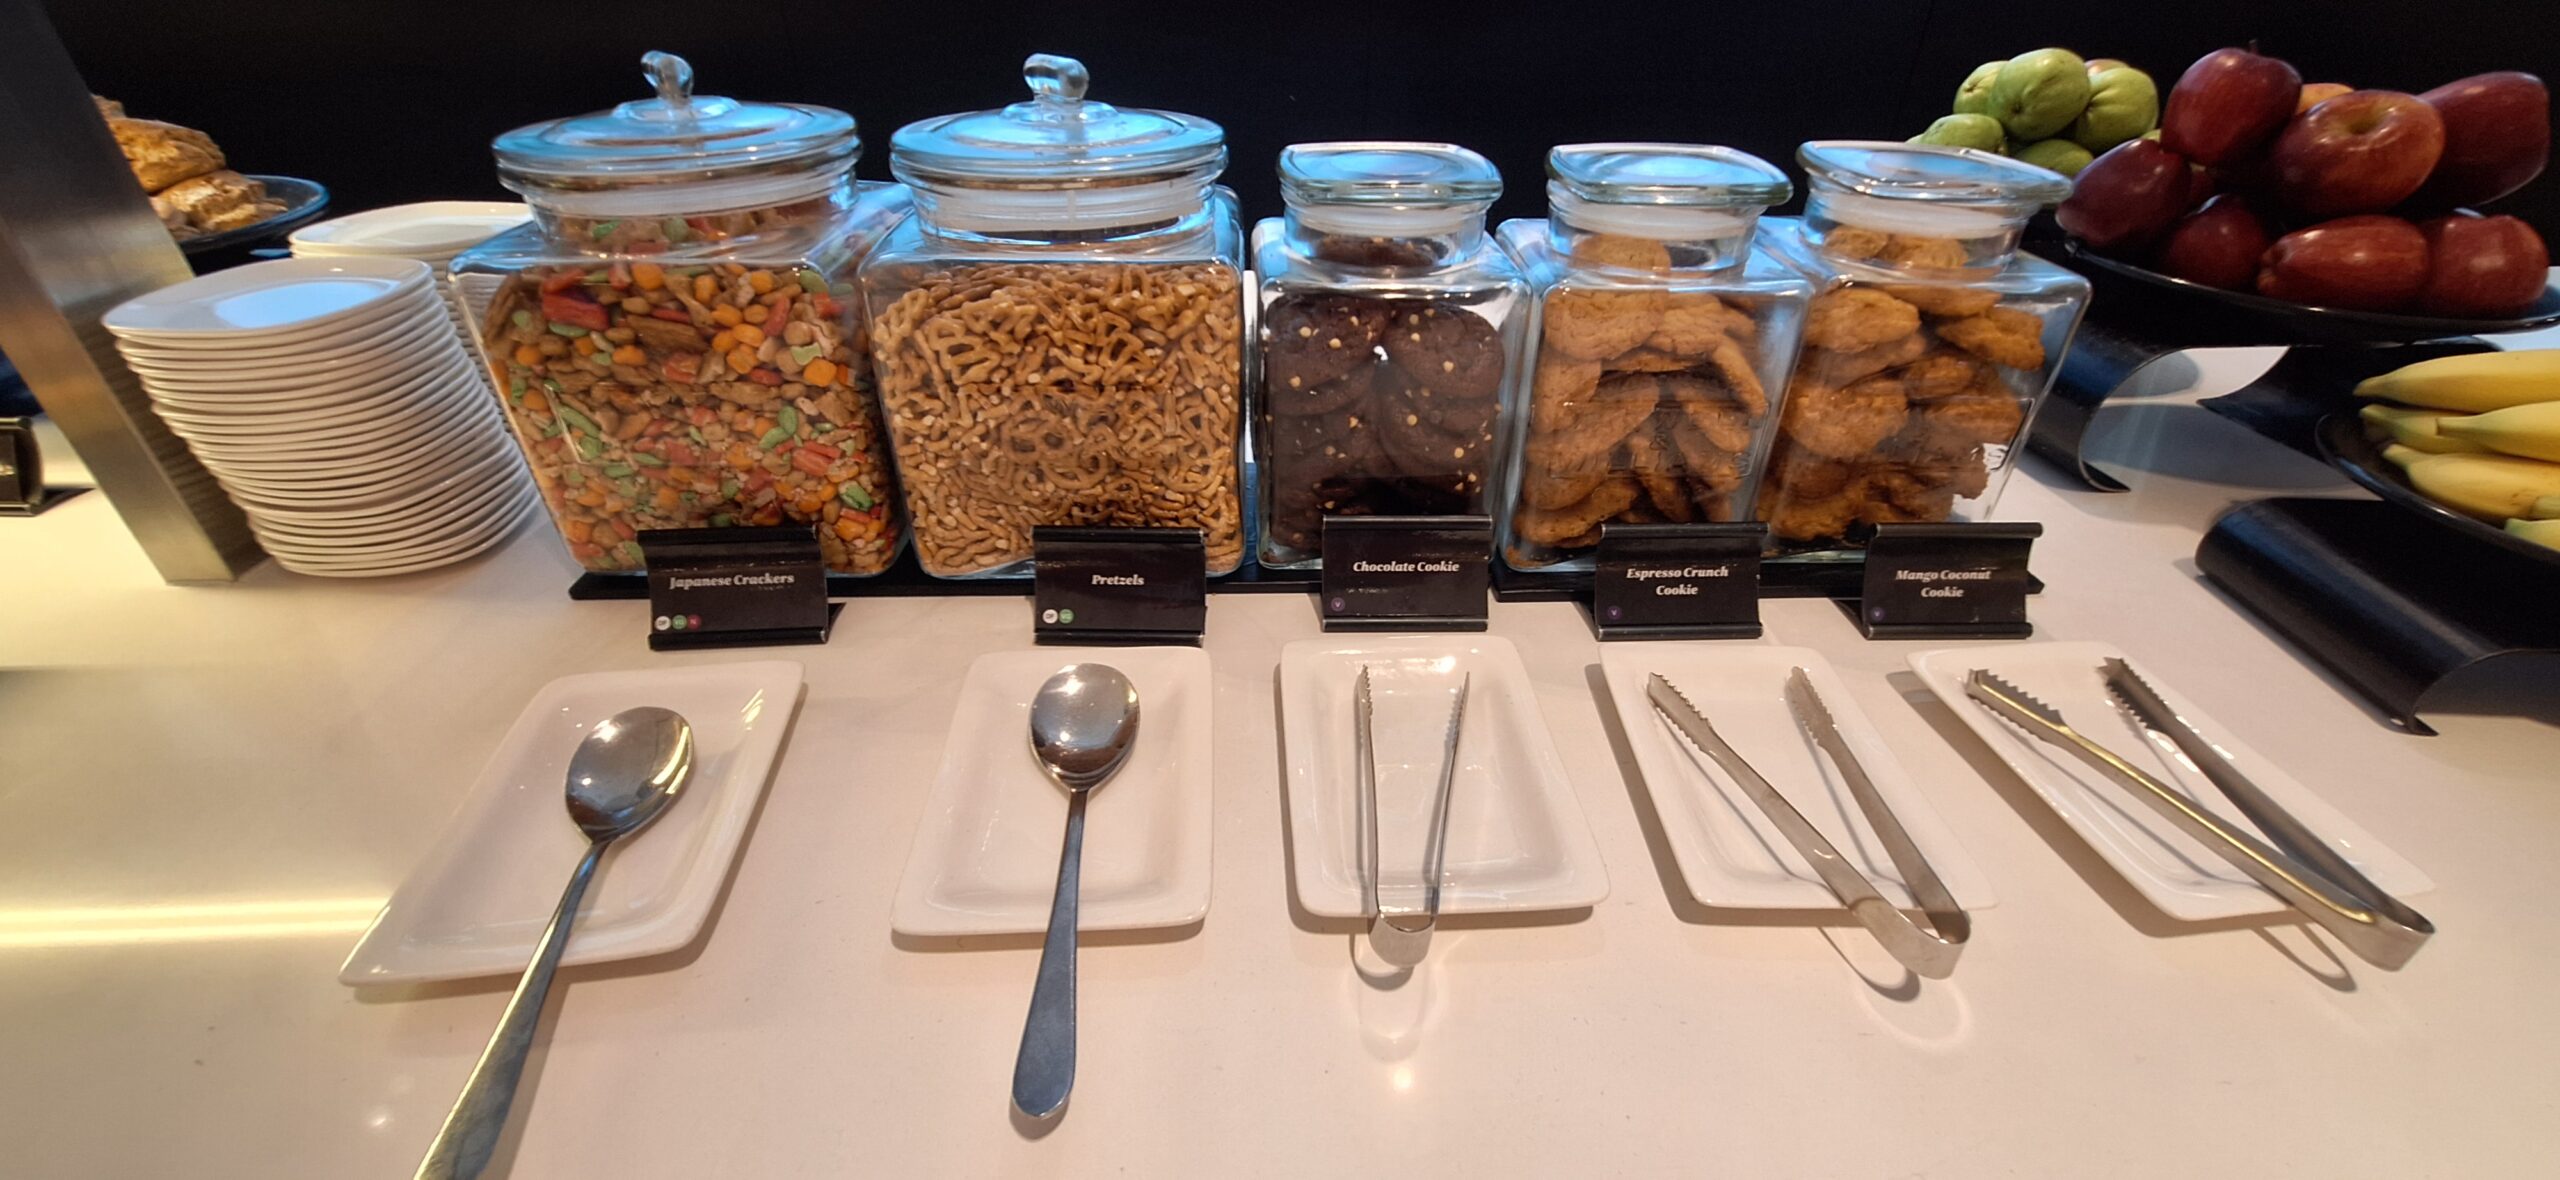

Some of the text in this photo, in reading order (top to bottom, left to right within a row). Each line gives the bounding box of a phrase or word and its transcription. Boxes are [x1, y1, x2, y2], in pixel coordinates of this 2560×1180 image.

[1353, 560, 1460, 572] Chocolate Cookie
[1626, 566, 1729, 581] Espresso Crunch
[1895, 569, 1992, 583] Mango Coconut
[669, 572, 795, 590] Japanese Crackers
[1091, 574, 1145, 586] Pretzels
[1656, 584, 1699, 596] Cookie
[1921, 586, 1965, 598] Cookie
